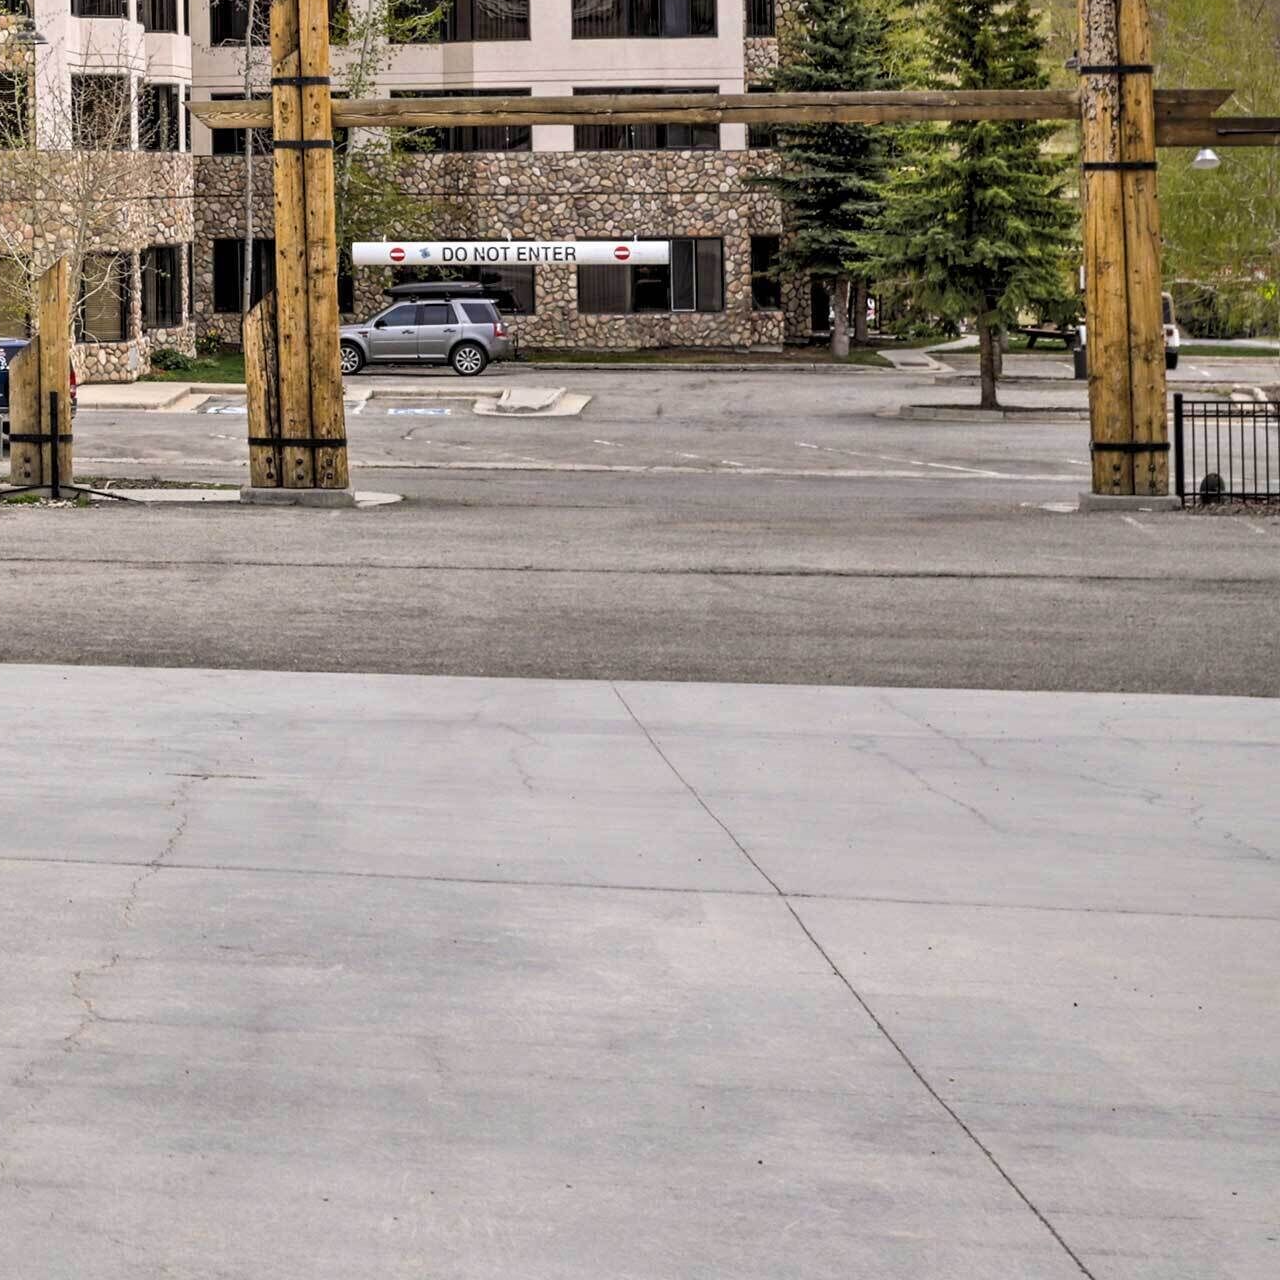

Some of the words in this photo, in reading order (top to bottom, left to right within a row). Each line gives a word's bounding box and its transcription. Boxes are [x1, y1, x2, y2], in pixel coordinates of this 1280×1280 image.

[442, 246, 468, 262] DO
[473, 246, 511, 262] NOT
[516, 246, 577, 262] ENTER
